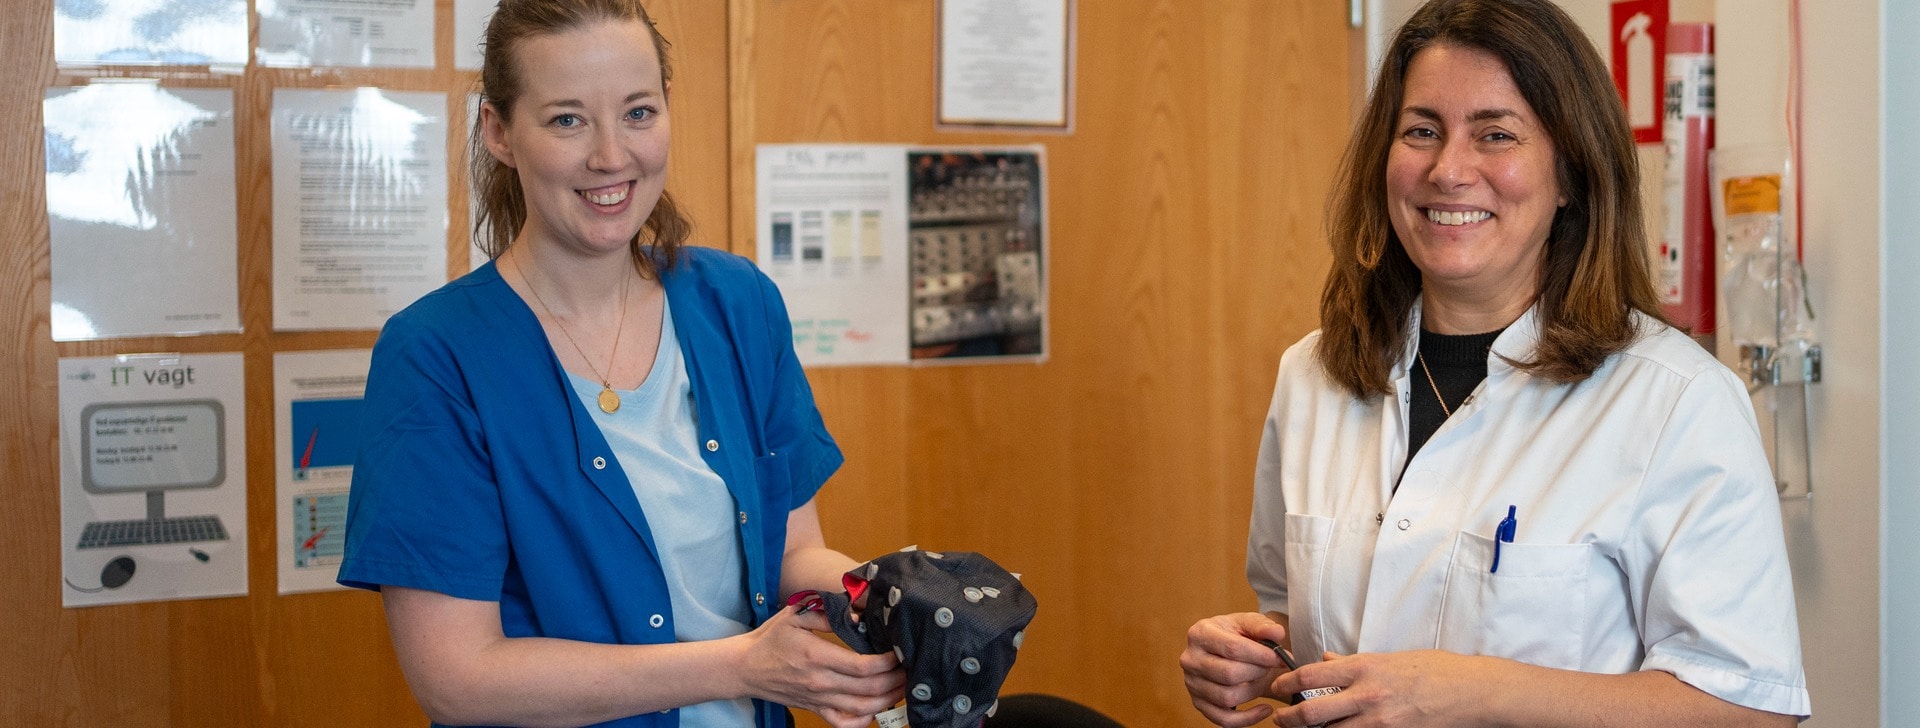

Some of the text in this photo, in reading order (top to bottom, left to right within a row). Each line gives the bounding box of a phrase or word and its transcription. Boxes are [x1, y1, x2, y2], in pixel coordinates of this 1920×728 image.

[111, 365, 195, 389] IT vagt
[1303, 687, 1341, 698] 52-58 CM
